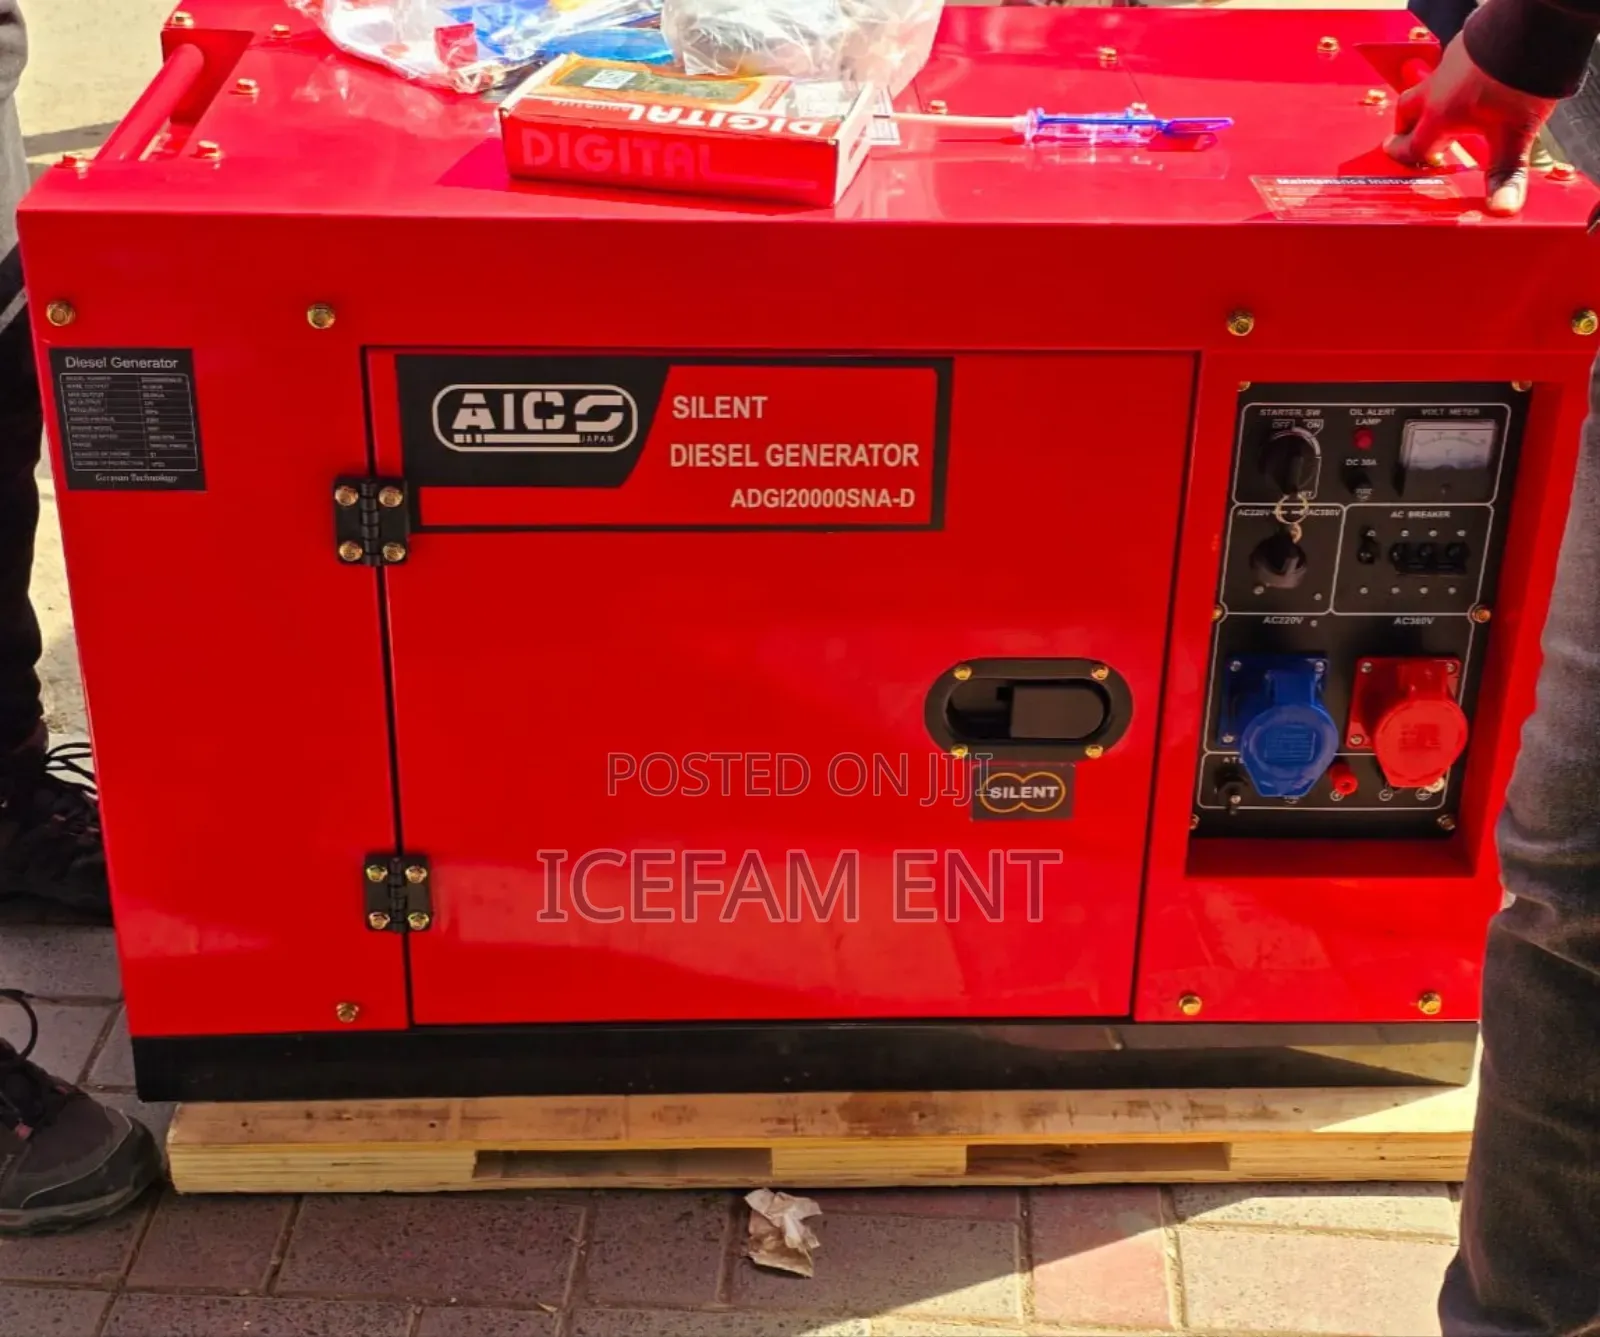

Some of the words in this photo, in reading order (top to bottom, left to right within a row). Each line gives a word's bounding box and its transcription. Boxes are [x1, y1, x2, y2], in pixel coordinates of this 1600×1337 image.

[629, 102, 825, 135] DIGITAL
[521, 128, 716, 179] DIGITAL
[65, 356, 107, 369] Diesel
[110, 356, 179, 369] Generator
[451, 391, 624, 432] AICS
[672, 395, 768, 419] SILENT
[1366, 408, 1396, 416] ALERT
[1421, 408, 1445, 416] VOLT
[1448, 408, 1480, 416] METER
[1272, 421, 1291, 429] OFF
[1307, 421, 1321, 429] ON
[582, 435, 614, 443] JAPAN
[670, 443, 759, 468] DIESEL
[765, 443, 919, 468] GENERATOR
[1345, 458, 1360, 466] DC
[95, 473, 129, 482] German
[130, 472, 178, 483] Technology
[730, 488, 915, 508] ADGI20000SNA-D
[1390, 510, 1404, 518] AC
[1408, 510, 1451, 518] BREAKER
[1262, 616, 1304, 624] AC220V
[1394, 616, 1435, 625] AC380V
[990, 786, 1059, 798] SILENT
